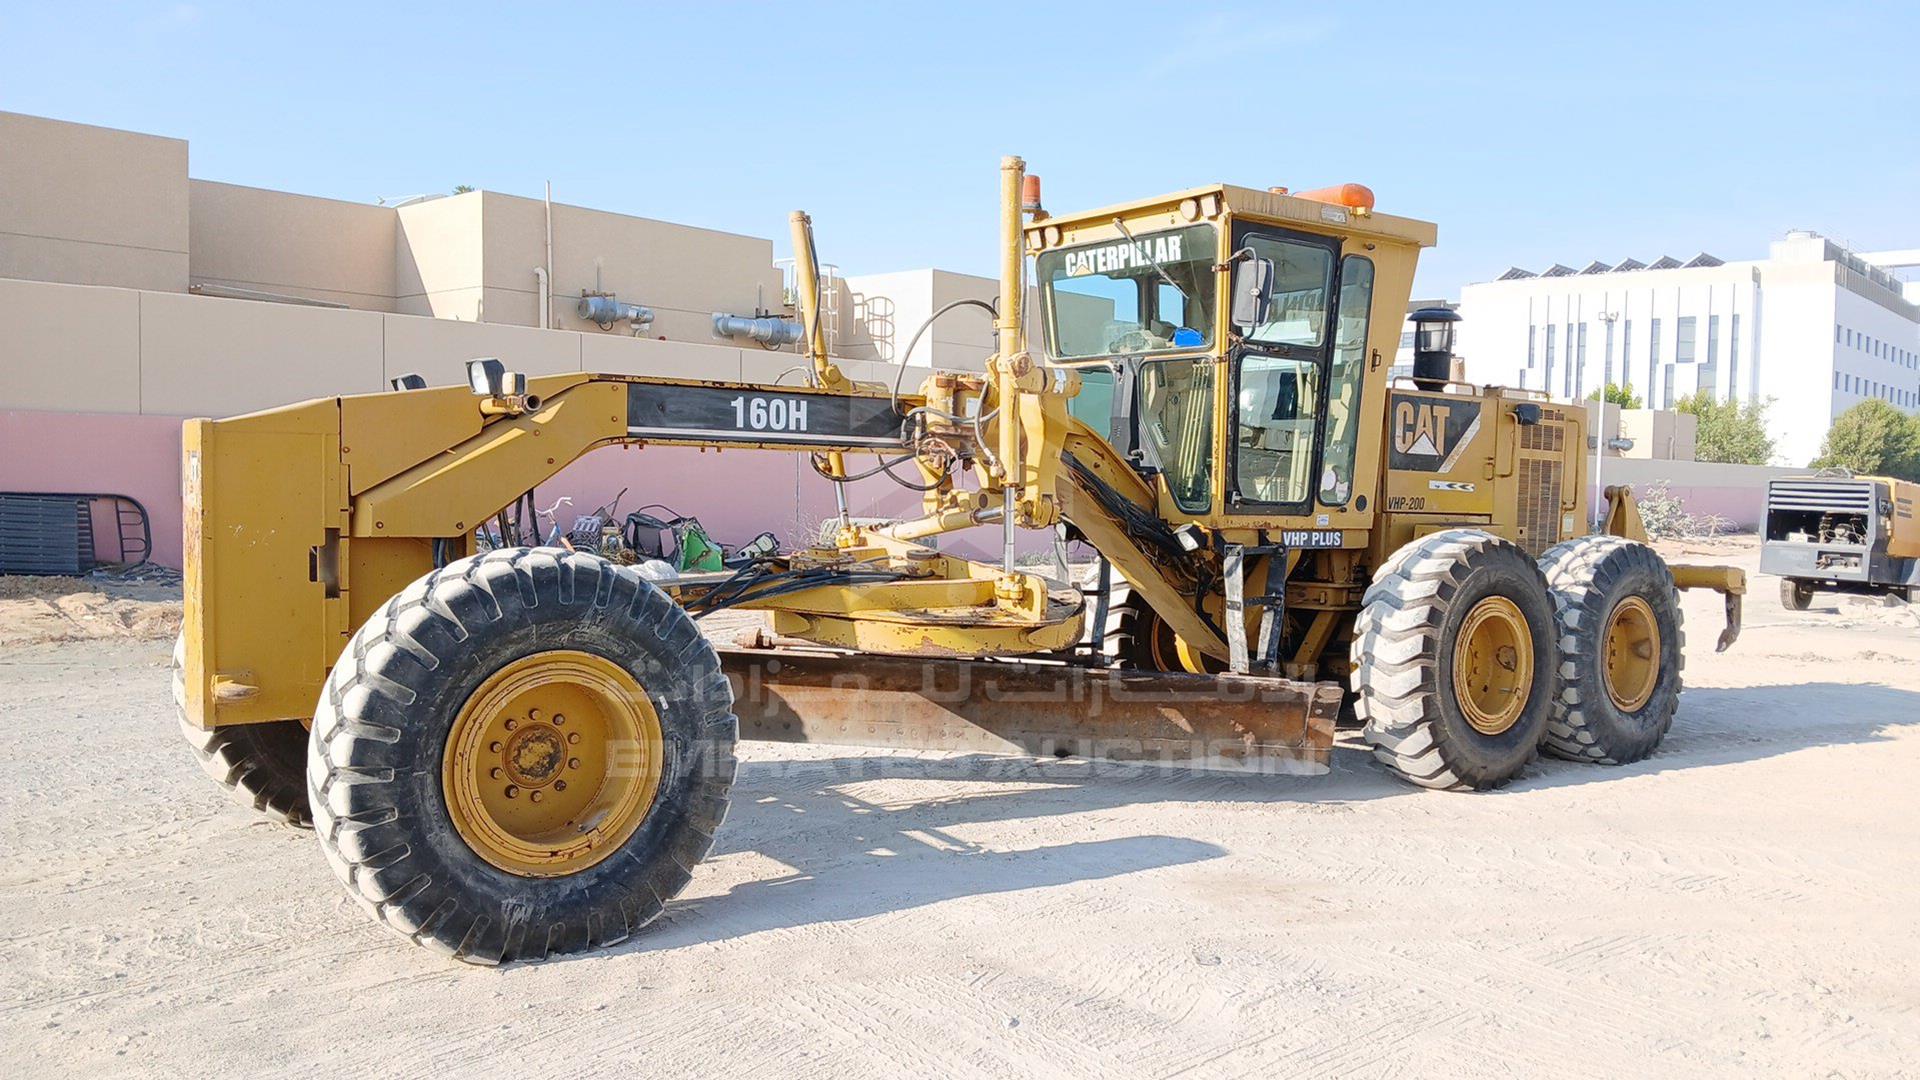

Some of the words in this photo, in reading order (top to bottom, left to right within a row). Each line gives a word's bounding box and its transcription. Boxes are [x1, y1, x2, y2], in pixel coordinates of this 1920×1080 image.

[1065, 235, 1182, 277] CATERPILLAR
[730, 396, 808, 431] 160H
[1395, 401, 1451, 456] CAT
[1388, 497, 1426, 510] VHP-200
[1282, 531, 1308, 546] VHP
[1311, 531, 1342, 546] PLUS
